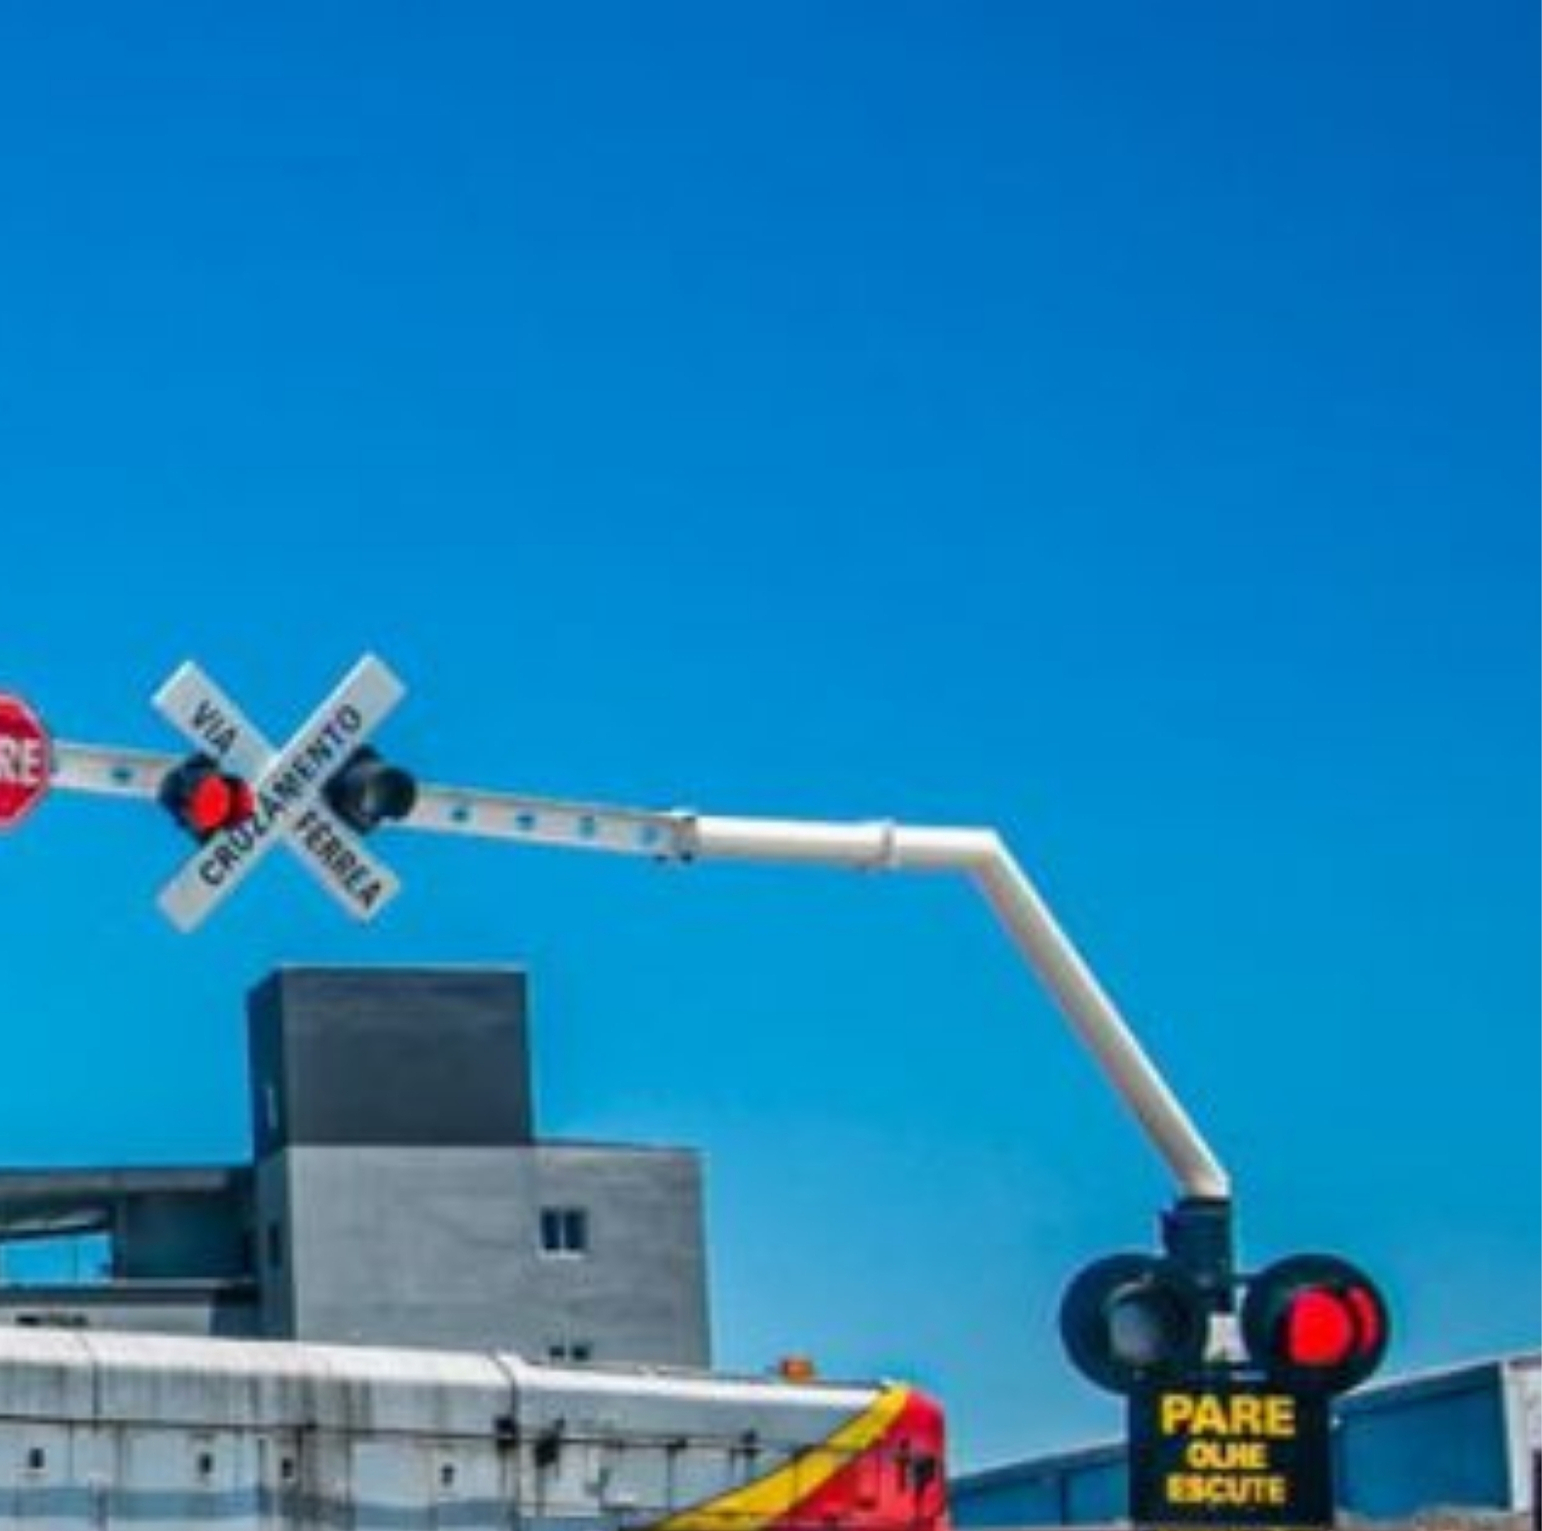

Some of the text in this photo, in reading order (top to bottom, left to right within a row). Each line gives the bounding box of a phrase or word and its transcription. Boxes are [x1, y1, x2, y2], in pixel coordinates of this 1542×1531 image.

[191, 700, 238, 756] VIA
[198, 704, 362, 886] CRUZAMENTO
[1161, 1393, 1295, 1436] PARE
[1186, 1441, 1268, 1468] OLHE
[1168, 1473, 1286, 1503] ESCUTE
